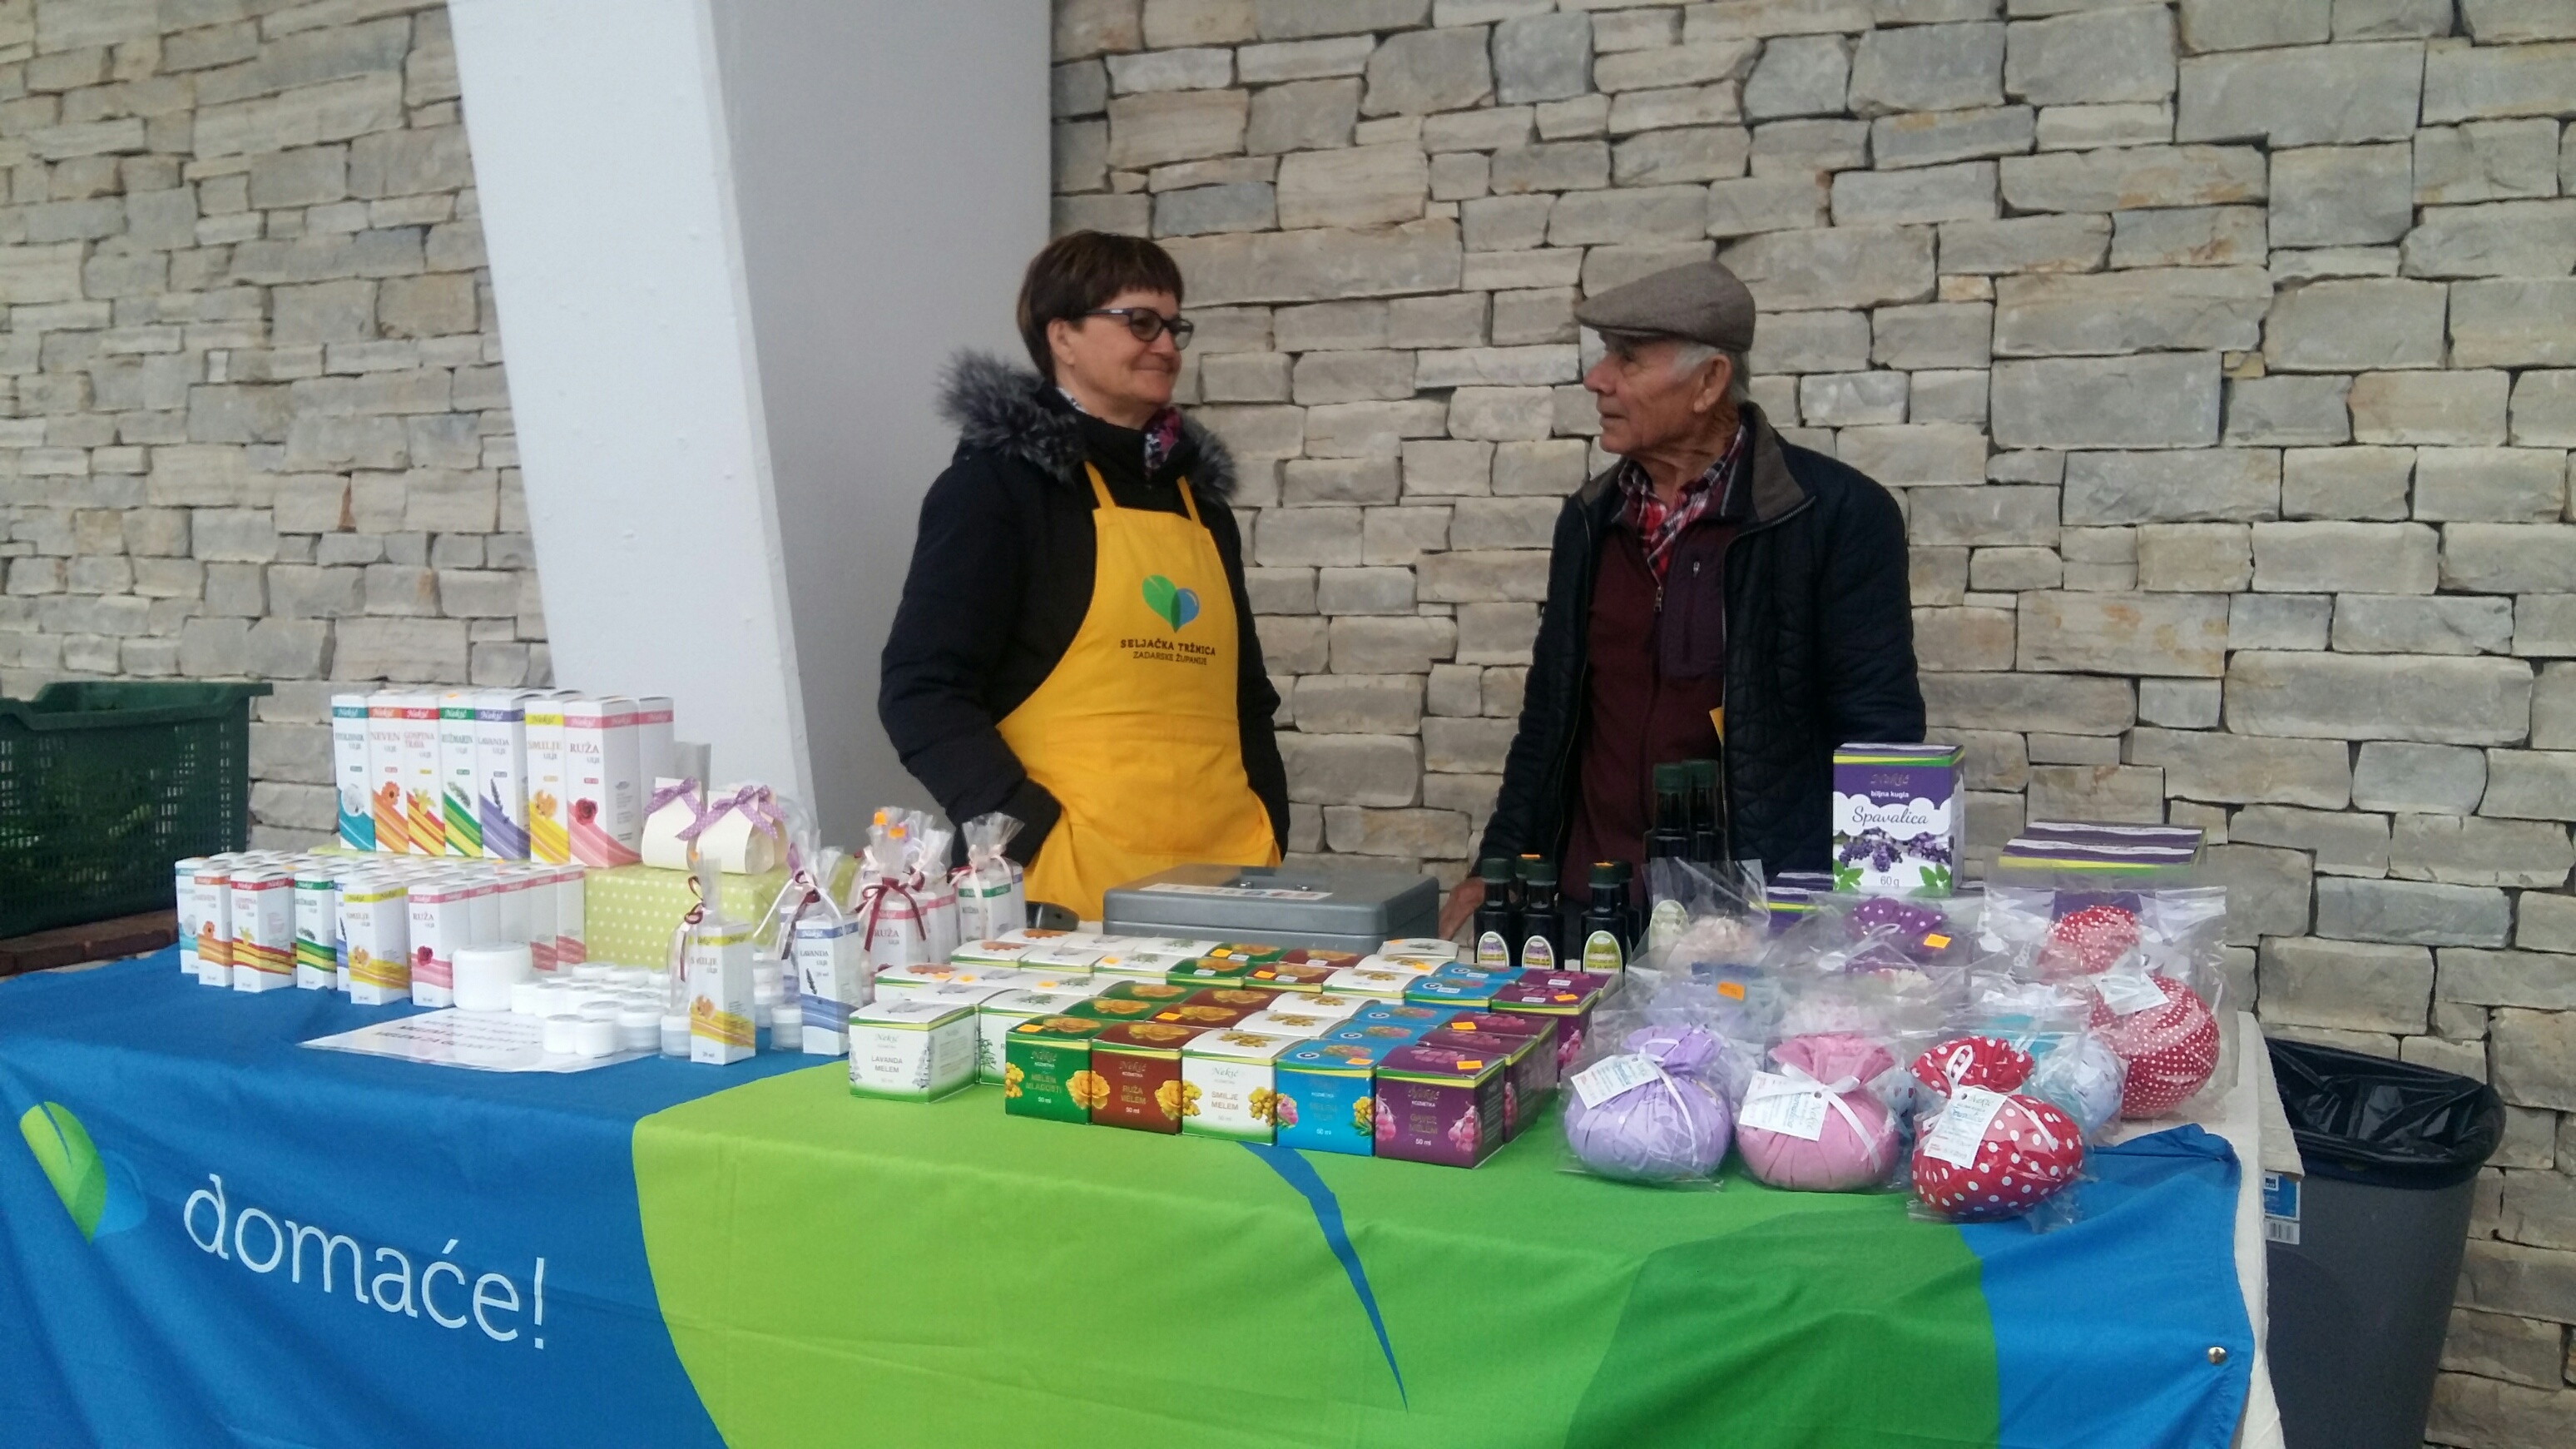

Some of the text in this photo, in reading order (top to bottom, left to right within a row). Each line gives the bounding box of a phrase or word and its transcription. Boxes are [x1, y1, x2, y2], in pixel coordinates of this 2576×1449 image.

[1120, 638, 1216, 656] SELJAČKA TRŽNICA
[1132, 651, 1207, 665] ZADARSKE ŽUPANIJE
[371, 732, 400, 741] NEVEN
[570, 742, 600, 754] RUŽA
[1890, 791, 1910, 799] kugla
[1852, 806, 1929, 826] Spavalica
[1880, 876, 1900, 887] 60 g
[413, 911, 434, 921] RUŽA
[871, 1055, 904, 1064] LAVANDA
[874, 1065, 899, 1074] MELEM
[1122, 1084, 1143, 1094] RUŽA
[1211, 1090, 1239, 1100] SMILJE
[1211, 1101, 1239, 1110] MELEM
[182, 1173, 545, 1350] domaće!
